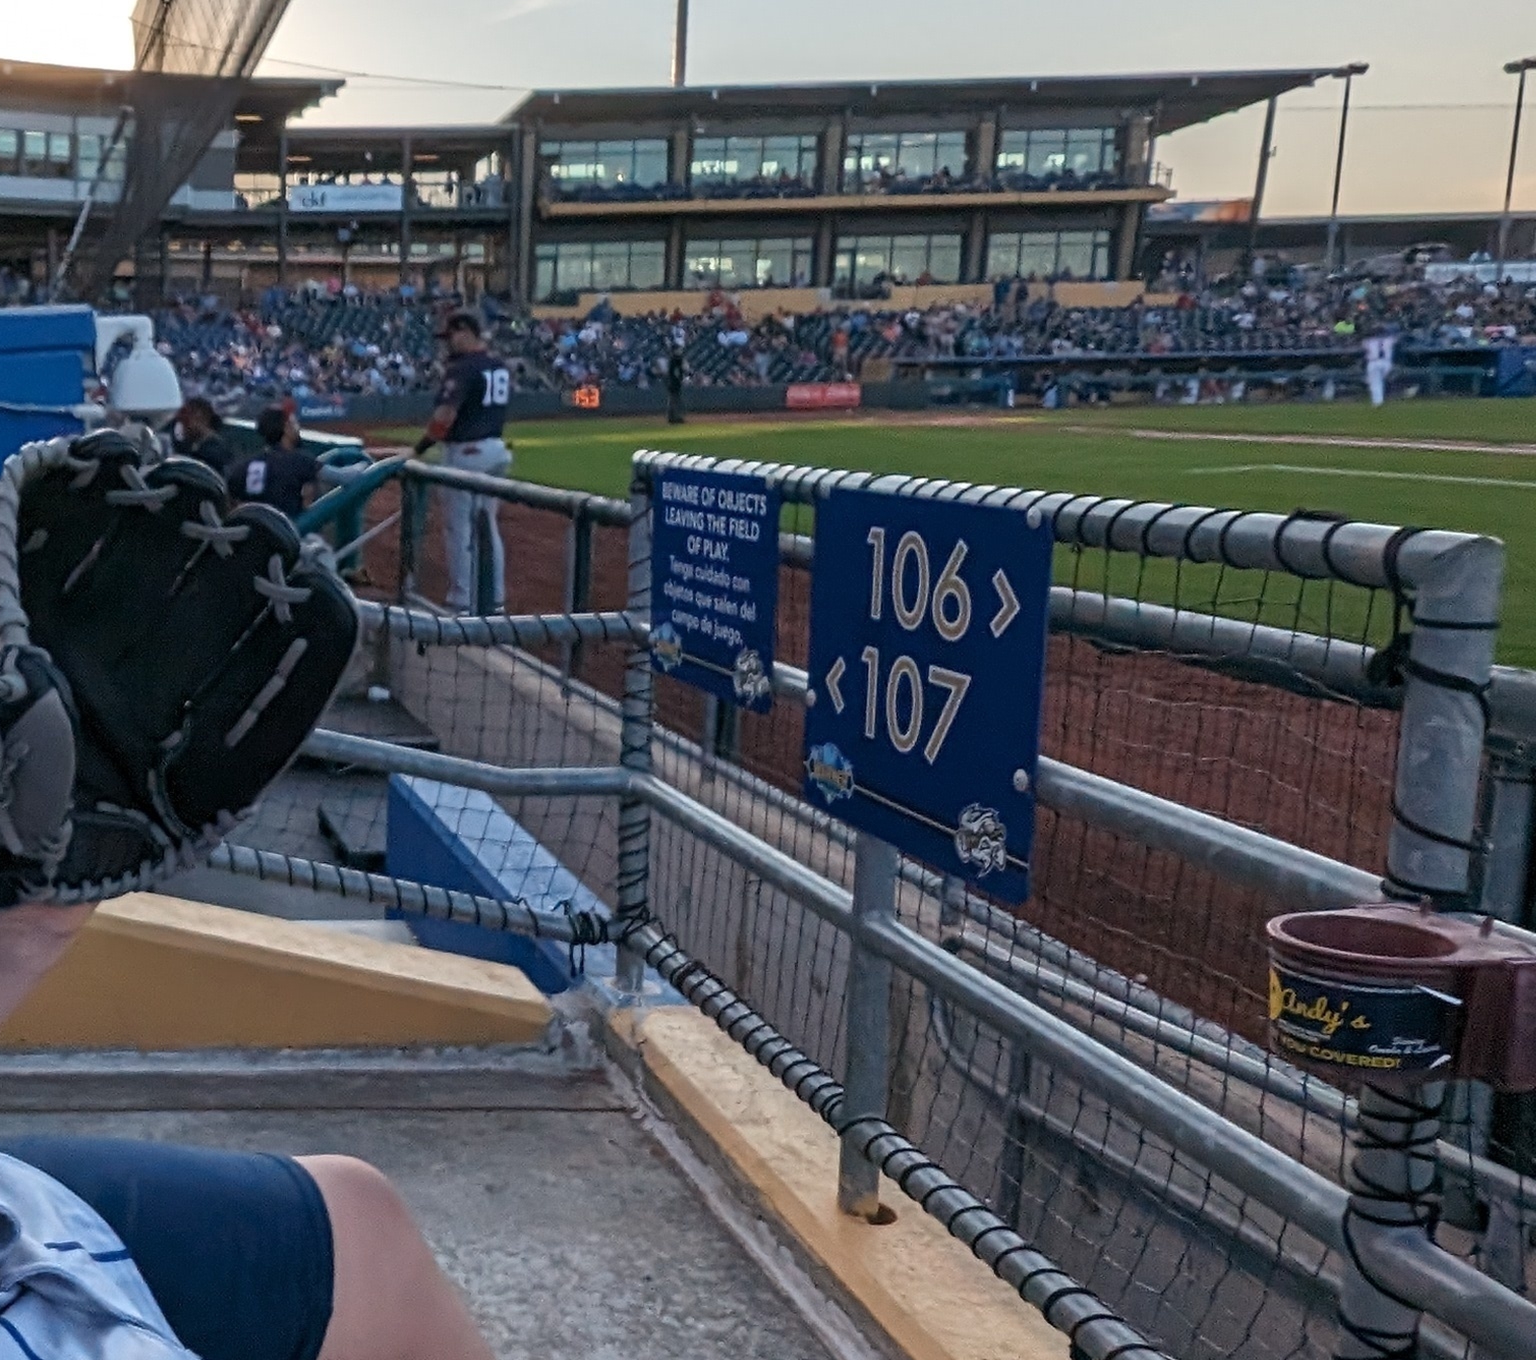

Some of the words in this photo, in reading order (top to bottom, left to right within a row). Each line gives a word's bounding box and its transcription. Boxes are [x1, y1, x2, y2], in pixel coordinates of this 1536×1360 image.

[482, 368, 510, 406] 18
[662, 481, 699, 506] BEWARE
[701, 486, 716, 507] OF
[718, 488, 767, 516] OBJECTS
[665, 505, 704, 531] LEAVING
[706, 513, 727, 536] THE
[728, 517, 761, 542] FIELD
[687, 534, 703, 555] OF
[703, 538, 730, 562] PLAY.
[695, 564, 731, 589] cuidado
[732, 575, 751, 593] con
[867, 526, 972, 641] 106
[695, 591, 713, 609] que
[714, 595, 739, 617] salen
[740, 601, 757, 622] del
[700, 614, 714, 635] de
[861, 645, 972, 765] 107
[1309, 1045, 1401, 1069] COVERED!
